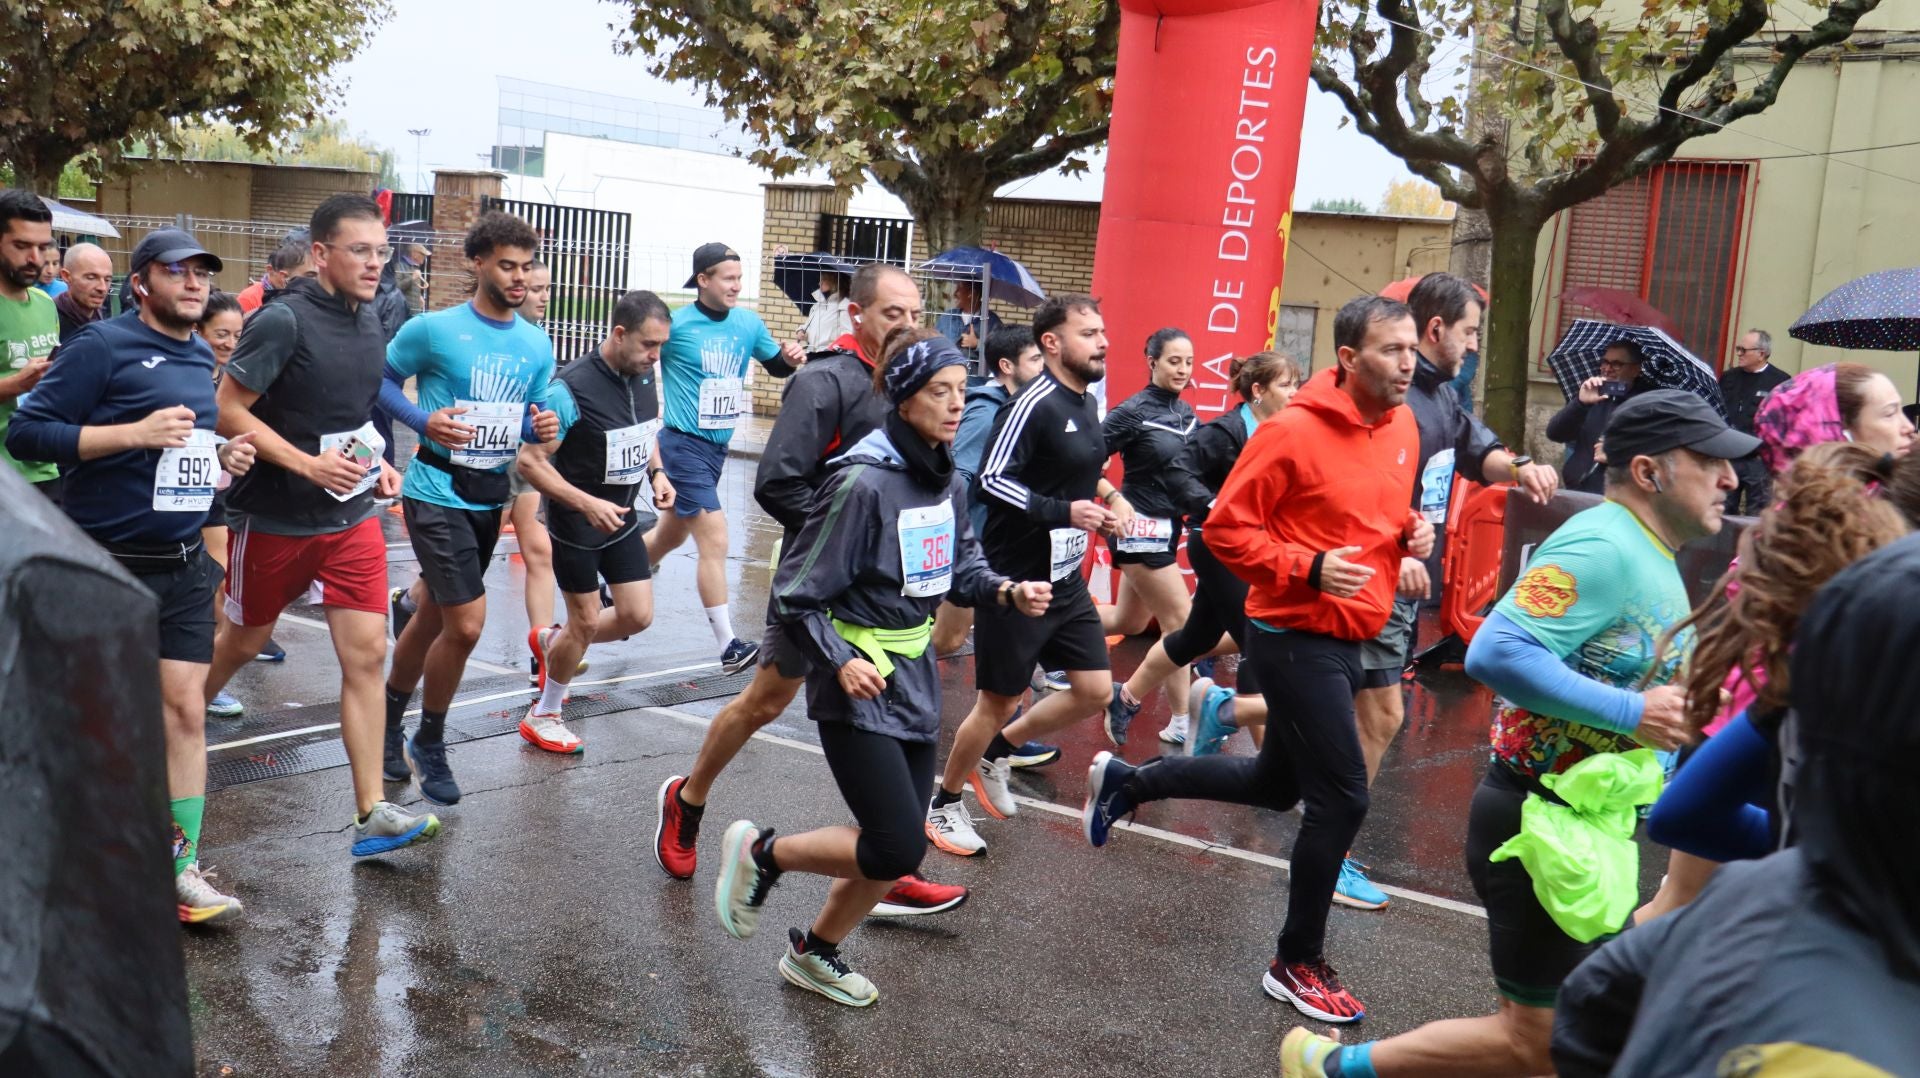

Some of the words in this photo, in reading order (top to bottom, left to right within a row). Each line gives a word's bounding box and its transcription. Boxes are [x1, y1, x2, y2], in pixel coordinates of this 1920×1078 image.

[1218, 45, 1277, 262] DEPORTES
[1207, 279, 1244, 333] DE
[713, 395, 736, 414] 1174
[622, 441, 648, 468] 1134
[178, 457, 212, 486] 992
[1128, 519, 1157, 537] 792
[922, 533, 950, 570] 362
